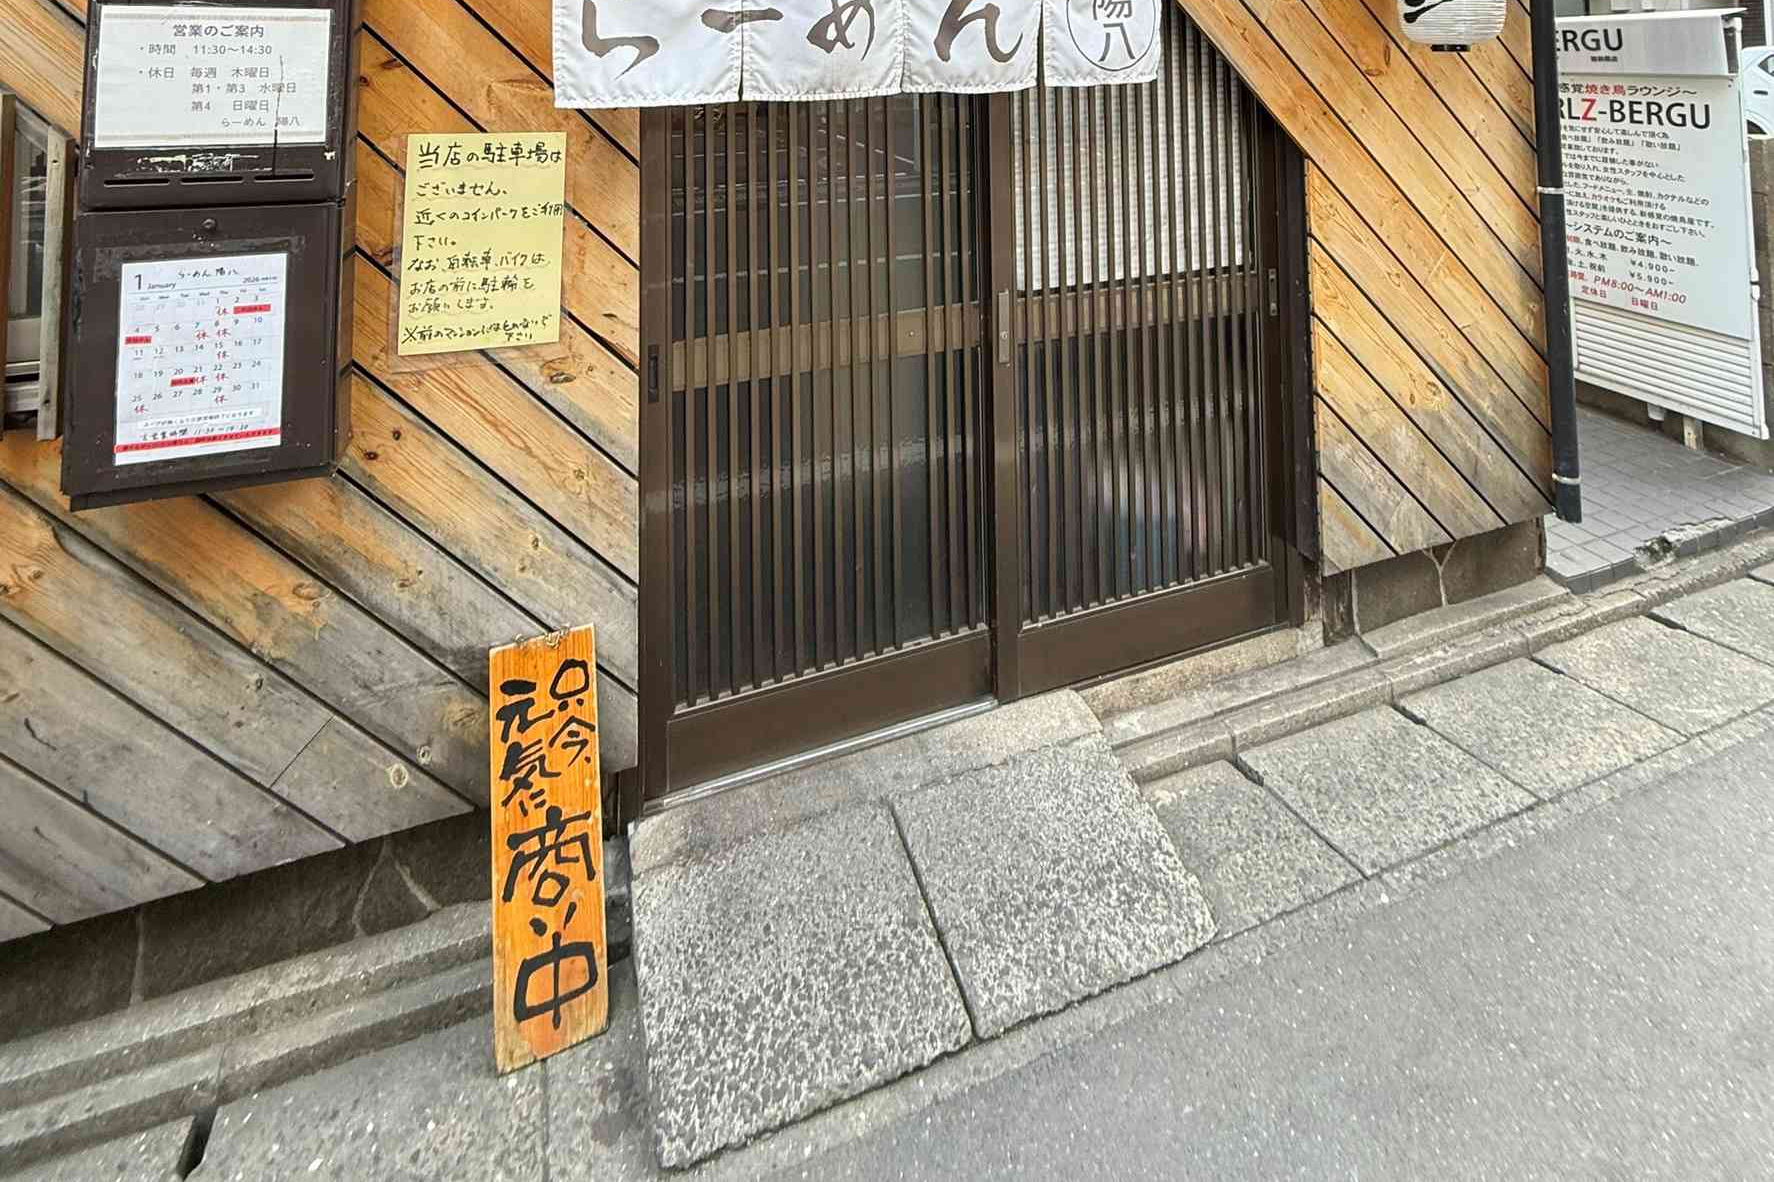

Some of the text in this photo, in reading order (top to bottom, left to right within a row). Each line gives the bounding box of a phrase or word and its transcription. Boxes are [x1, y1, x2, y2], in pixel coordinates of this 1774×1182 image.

[173, 24, 264, 38] 営業のご案内
[191, 67, 217, 78] 毎週
[232, 67, 270, 78] 木曜日
[233, 100, 270, 111] 日曜日
[418, 142, 562, 168] 当店の駐車場は
[135, 274, 176, 291] 1 January
[1581, 285, 1659, 311] 定休日 日曜日
